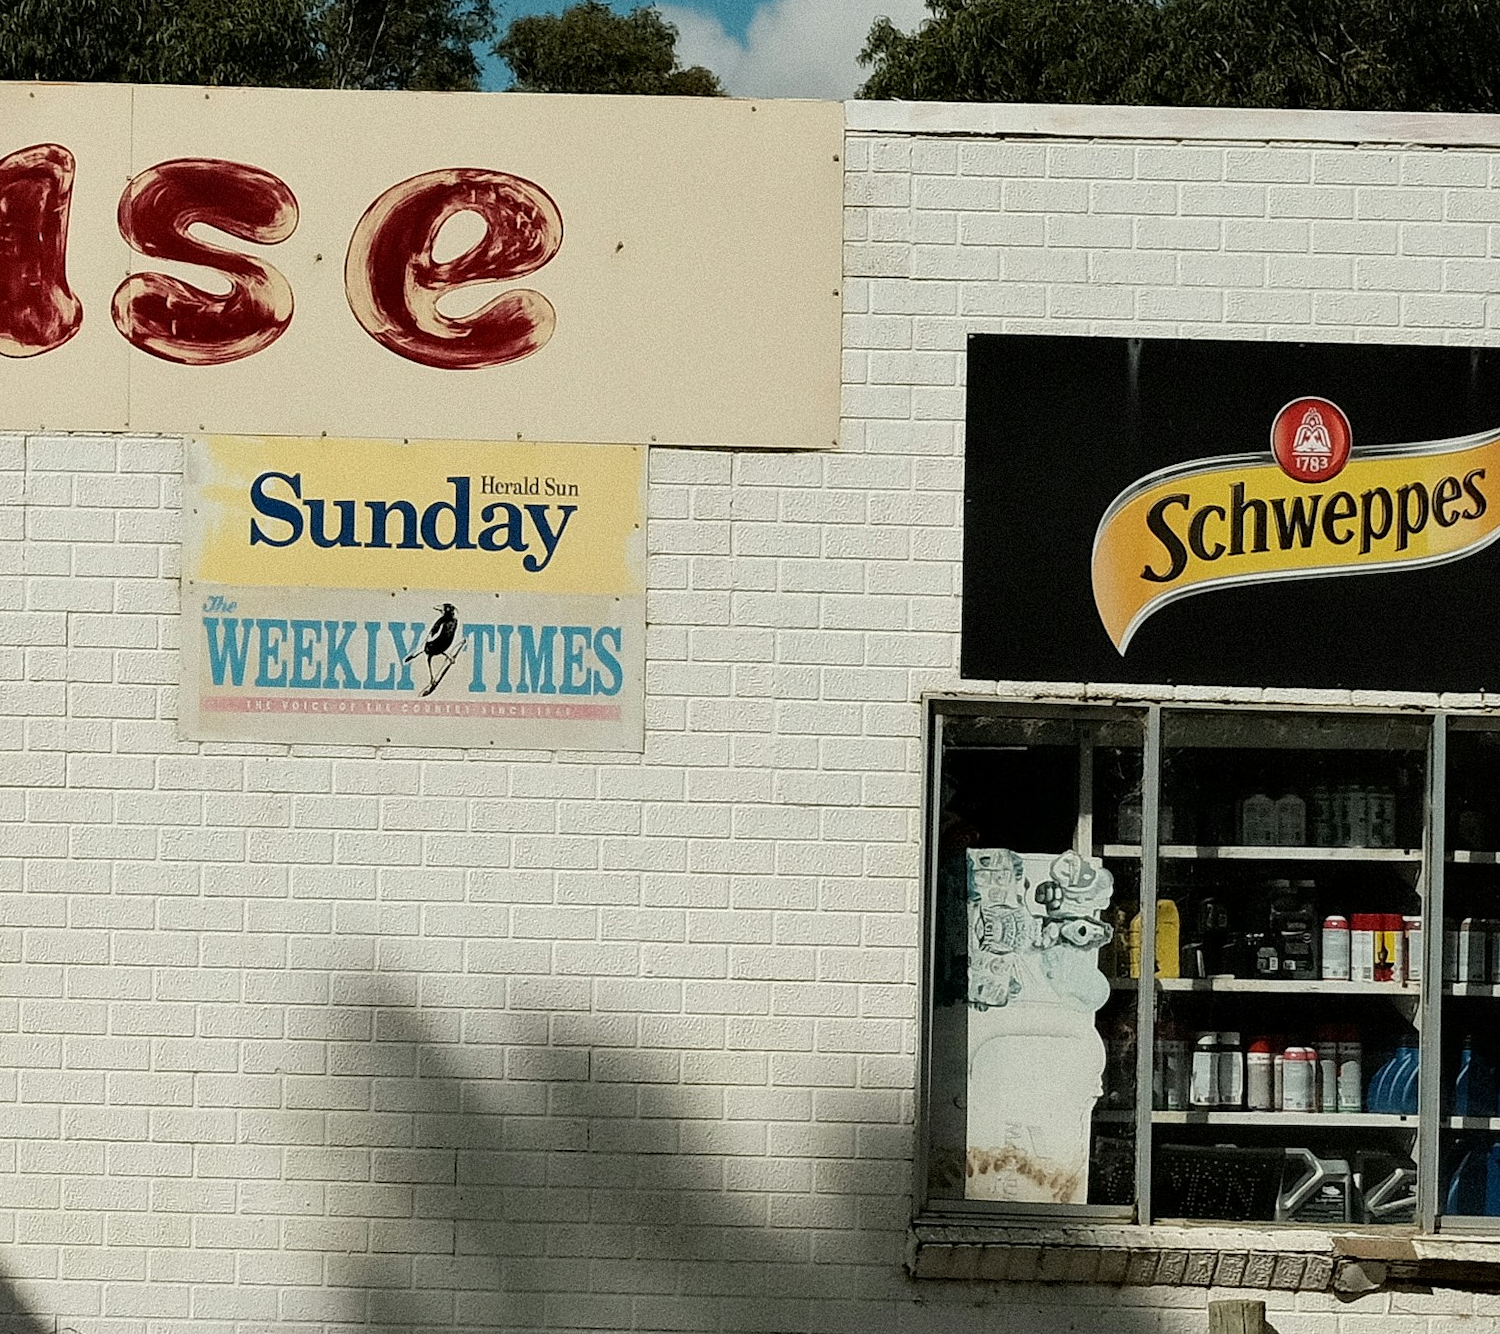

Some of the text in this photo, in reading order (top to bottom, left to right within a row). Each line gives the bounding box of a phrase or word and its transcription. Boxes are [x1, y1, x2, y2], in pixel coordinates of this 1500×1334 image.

[481, 476, 579, 496] Herald Sun
[1295, 456, 1329, 473] 1783
[250, 472, 578, 573] Sunday
[1140, 468, 1488, 583] Schweppes
[203, 617, 623, 697] WEEKLY TIMES
